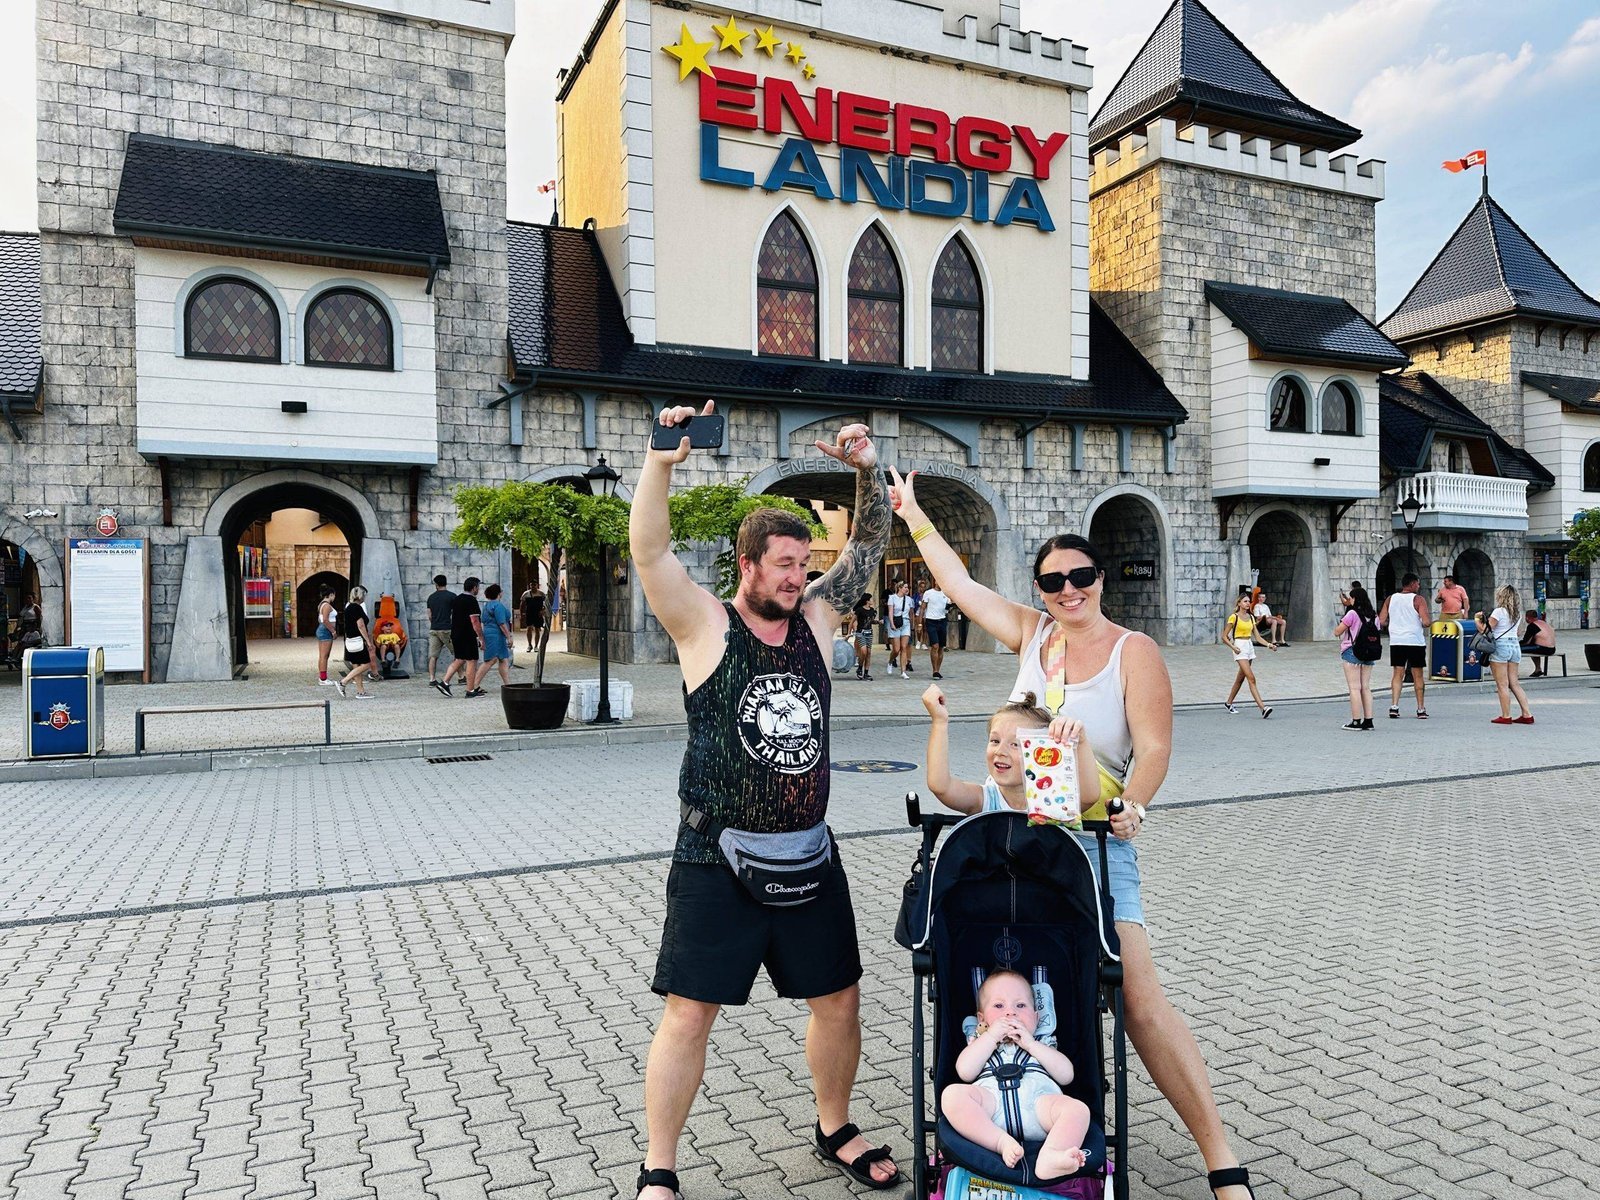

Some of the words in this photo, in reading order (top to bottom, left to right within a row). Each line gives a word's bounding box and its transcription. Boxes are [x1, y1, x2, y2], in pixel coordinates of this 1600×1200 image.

[698, 66, 1069, 180] ENERGY
[699, 123, 1056, 232] LANDIA
[100, 519, 115, 530] EL
[742, 678, 785, 723] PHANAN
[789, 678, 821, 720] ISLAND
[53, 715, 68, 724] EL
[755, 738, 819, 765] THAILAND
[765, 882, 820, 895] Champion
